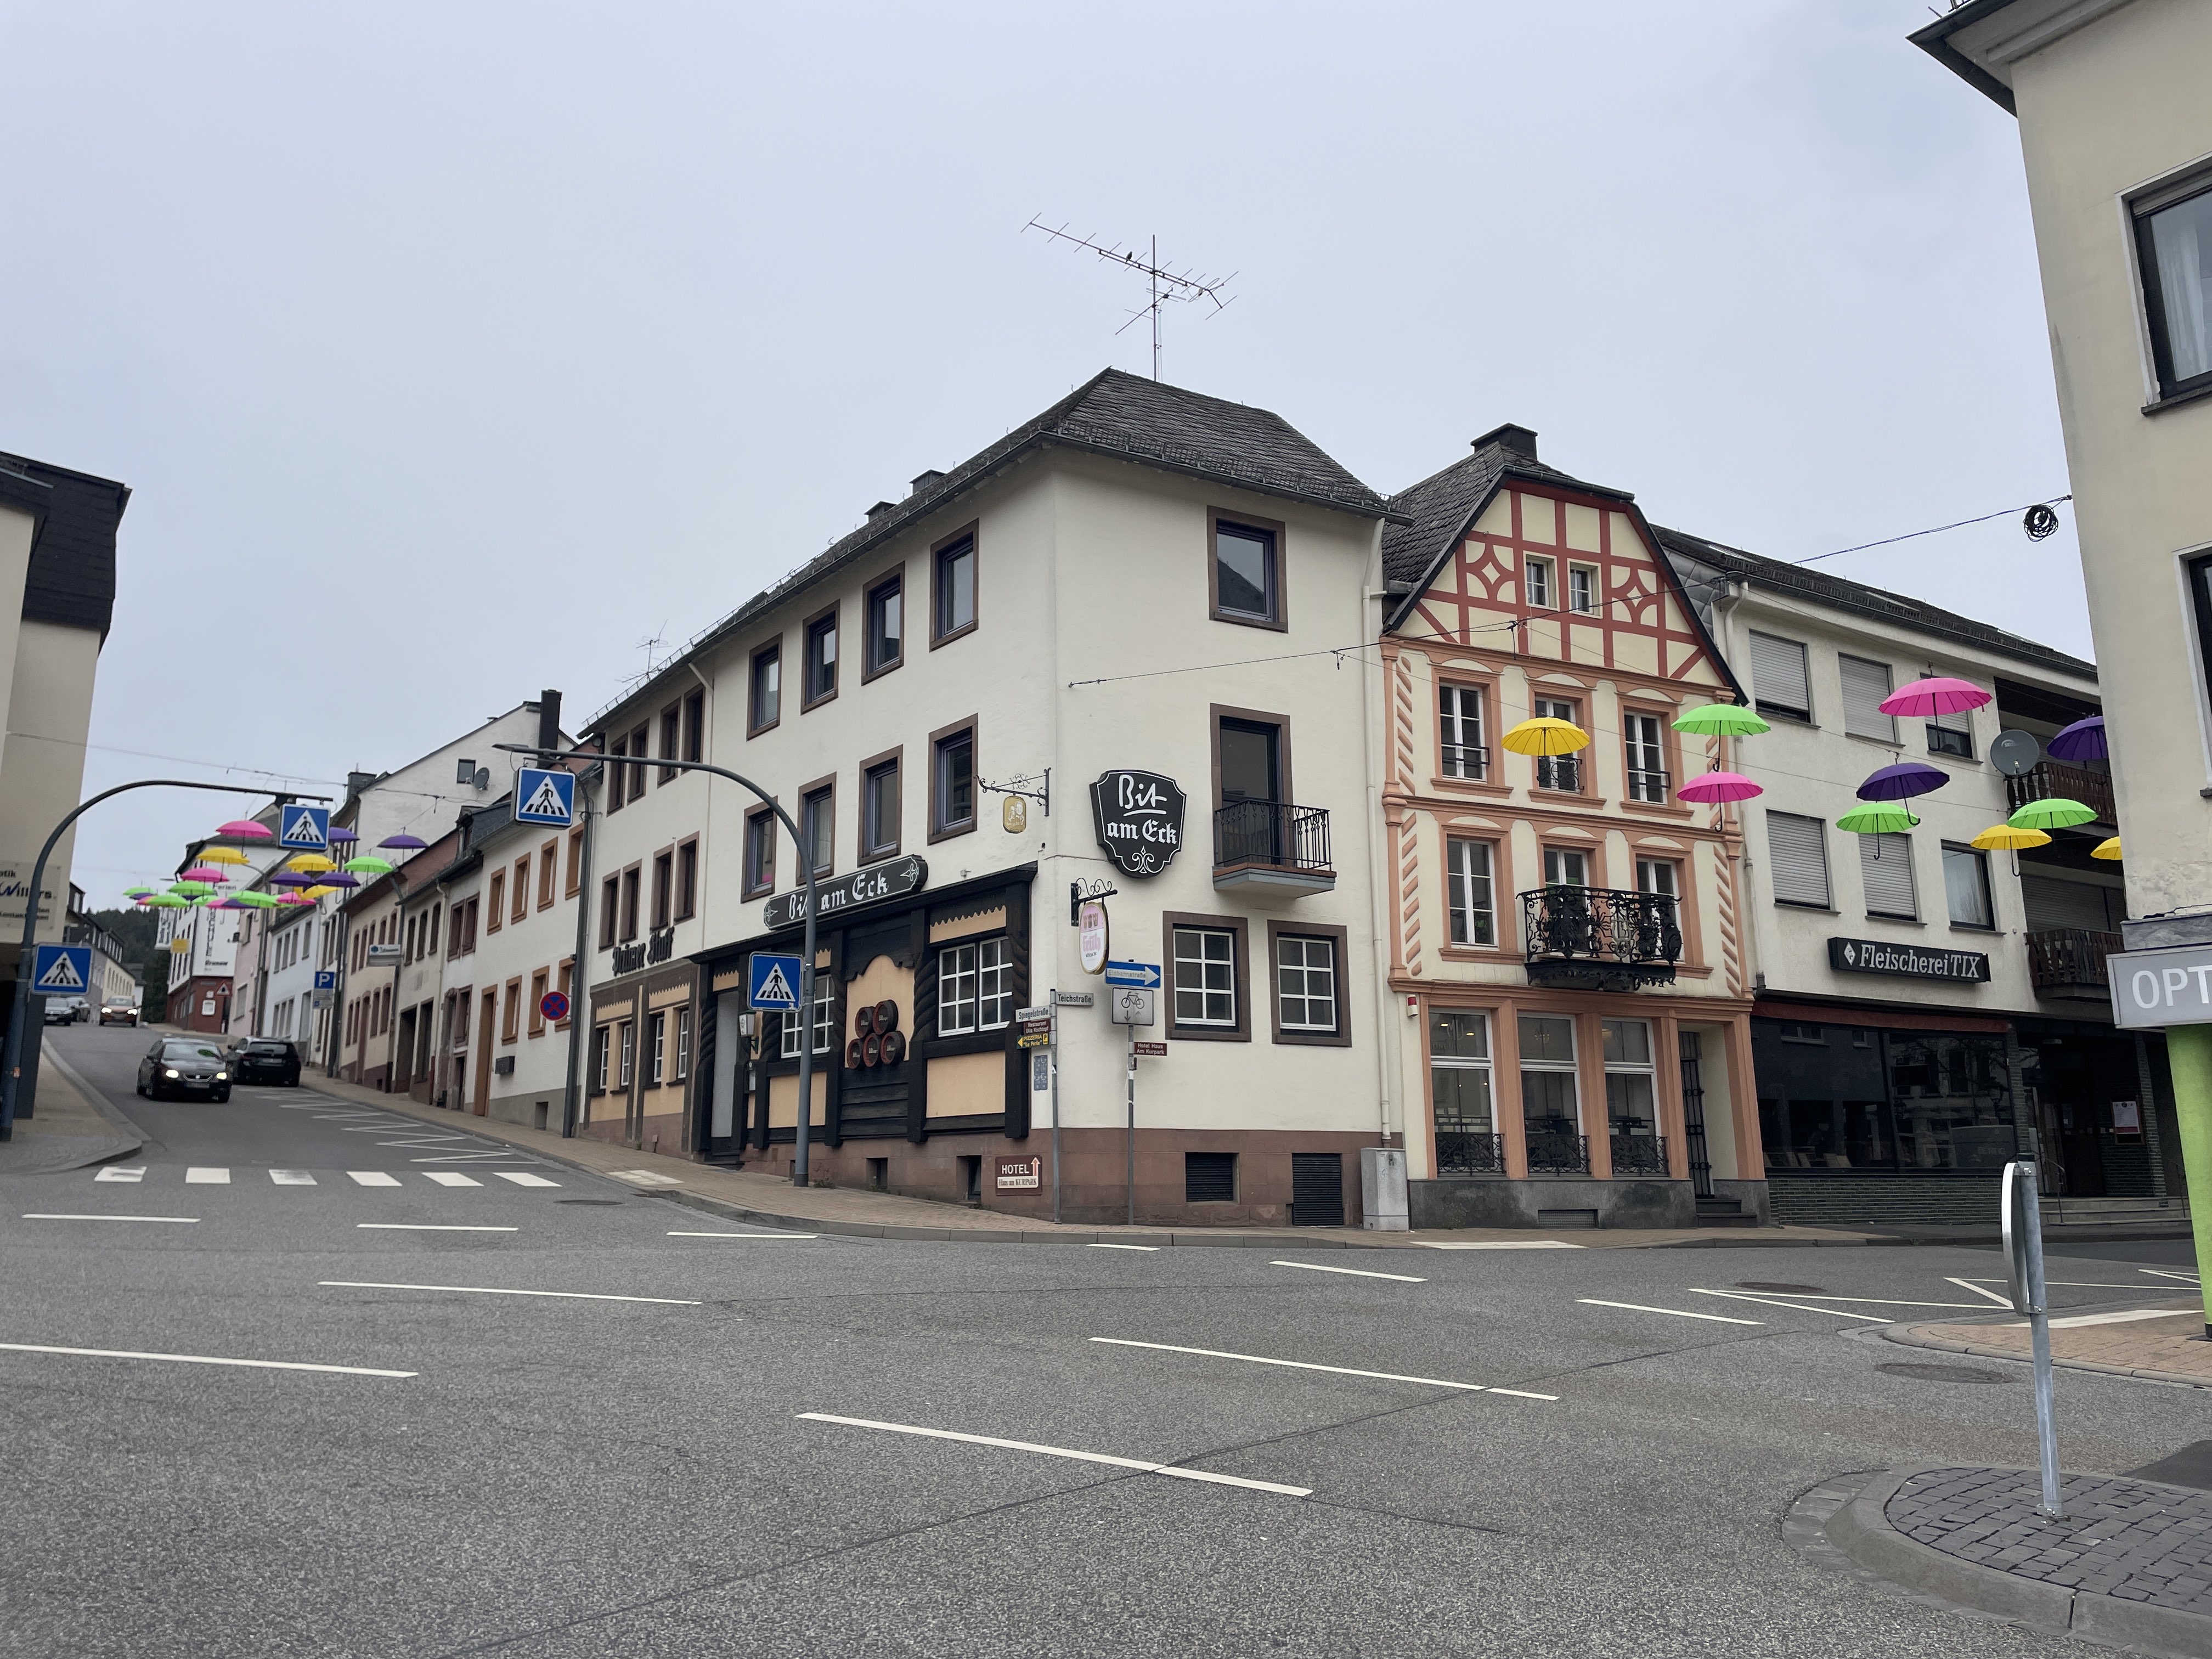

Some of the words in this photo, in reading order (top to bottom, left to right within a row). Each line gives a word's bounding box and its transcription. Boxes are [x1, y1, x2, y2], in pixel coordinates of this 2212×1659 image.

[1119, 774, 1167, 809] Bit
[1107, 822, 1139, 840] am
[1142, 819, 1177, 844] Eck
[788, 894, 809, 919] Bi
[821, 889, 847, 910] am
[852, 869, 889, 901] Eck
[1859, 943, 1948, 975] Fleischerei
[1950, 953, 1980, 979] TIX
[318, 973, 330, 988] P
[1108, 969, 1146, 978] Einbahnstraße
[2132, 964, 2212, 1009] OPT
[1058, 994, 1092, 1003] Teichstraße
[1018, 1008, 1048, 1020] Spiegelstraße
[1002, 1164, 1029, 1174] HOTEL
